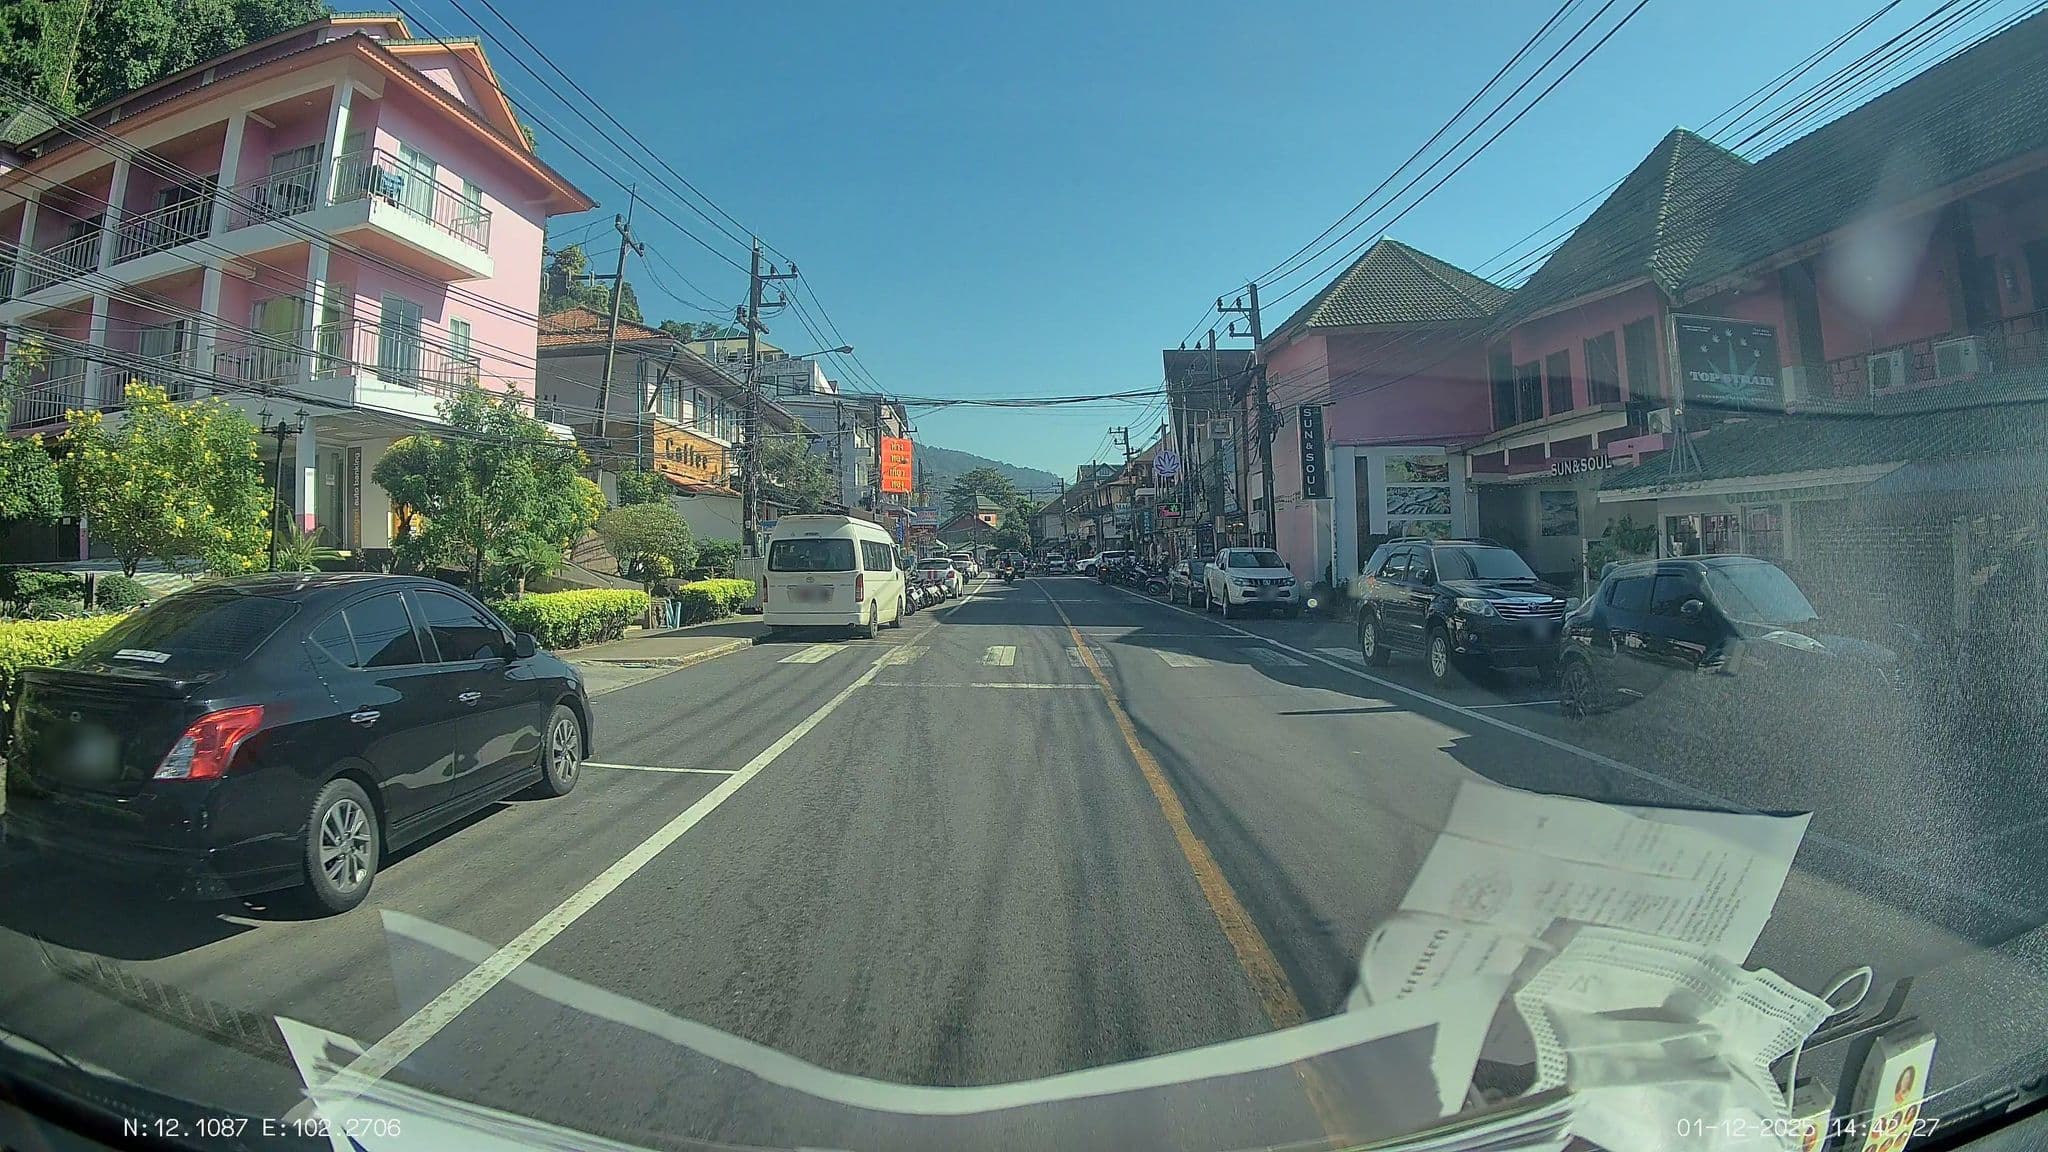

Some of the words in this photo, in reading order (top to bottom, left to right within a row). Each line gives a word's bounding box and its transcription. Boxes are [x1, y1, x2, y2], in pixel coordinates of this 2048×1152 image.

[1689, 371, 1719, 383] TOP
[1722, 374, 1775, 387] STRAIN
[666, 437, 708, 470] Coffee
[1303, 408, 1316, 496] SUN&SOUL
[1551, 454, 1613, 477] SUN&SOUL
